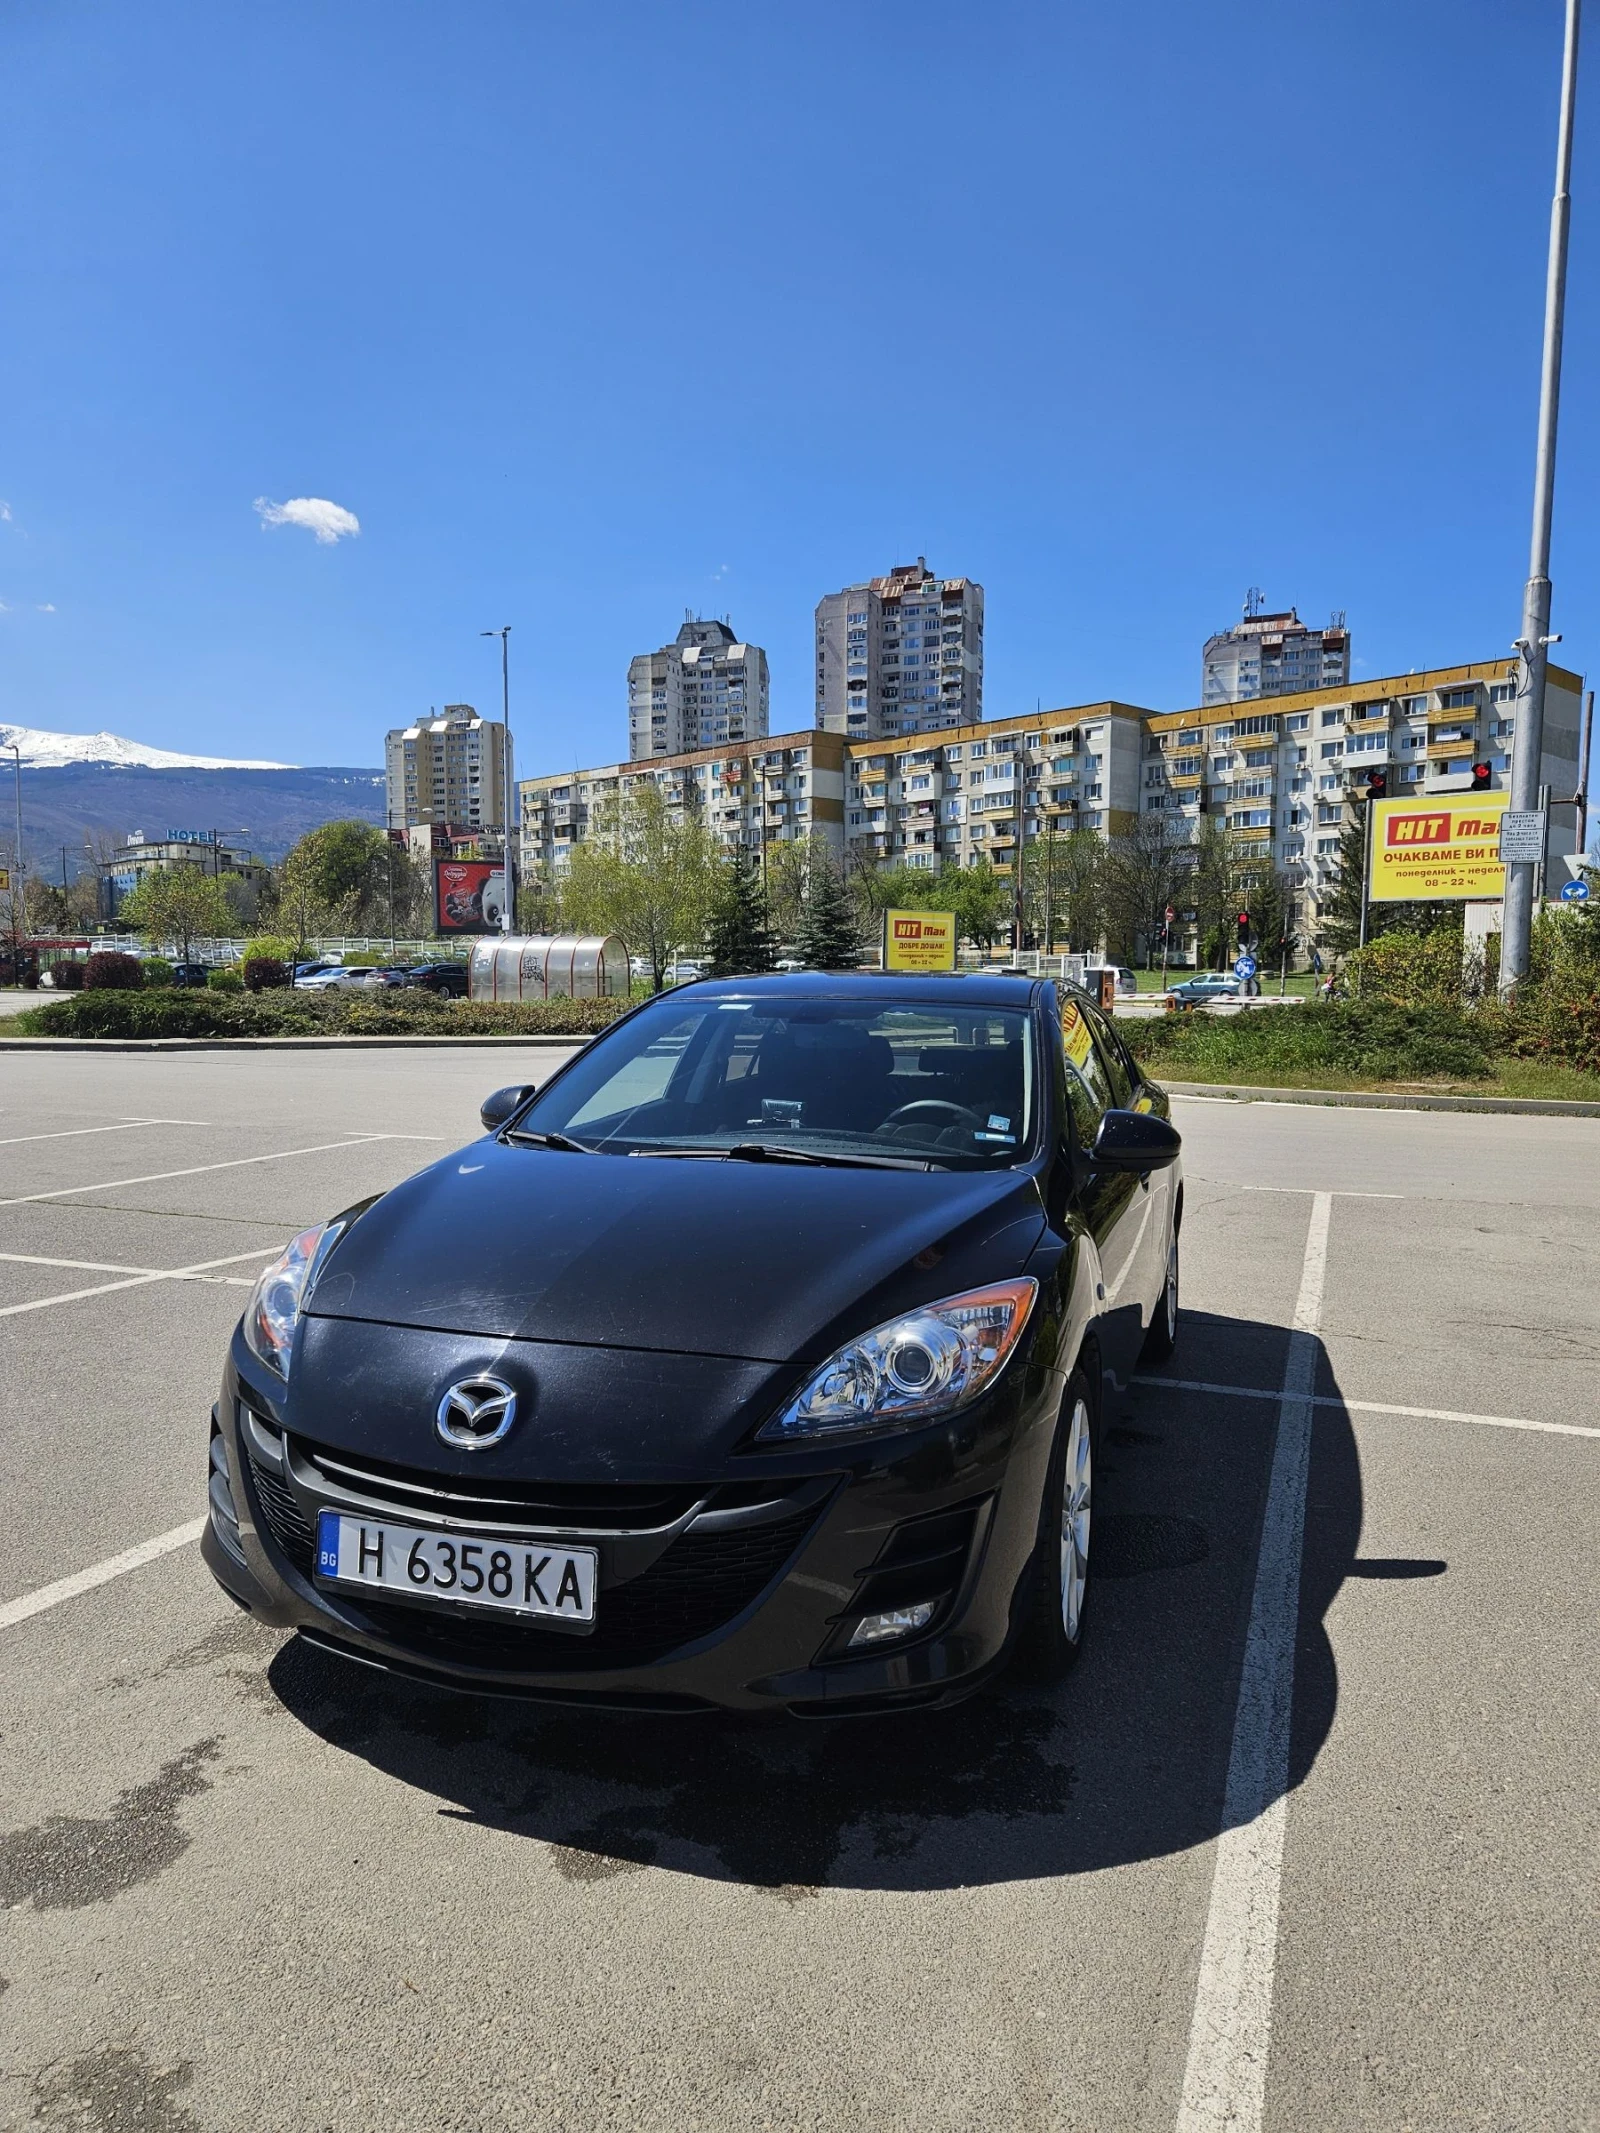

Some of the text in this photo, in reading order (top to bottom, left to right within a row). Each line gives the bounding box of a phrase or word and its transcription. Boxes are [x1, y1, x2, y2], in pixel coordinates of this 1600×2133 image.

[166, 828, 215, 843] HOTEL
[1395, 819, 1444, 841] HIT
[1384, 850, 1462, 863] ОЧАКВАМЕ
[1465, 850, 1485, 860] ВИ
[1396, 868, 1456, 878] понеделник
[1468, 866, 1504, 877] неделя
[898, 924, 945, 936] HIT Max
[320, 1550, 337, 1567] BG
